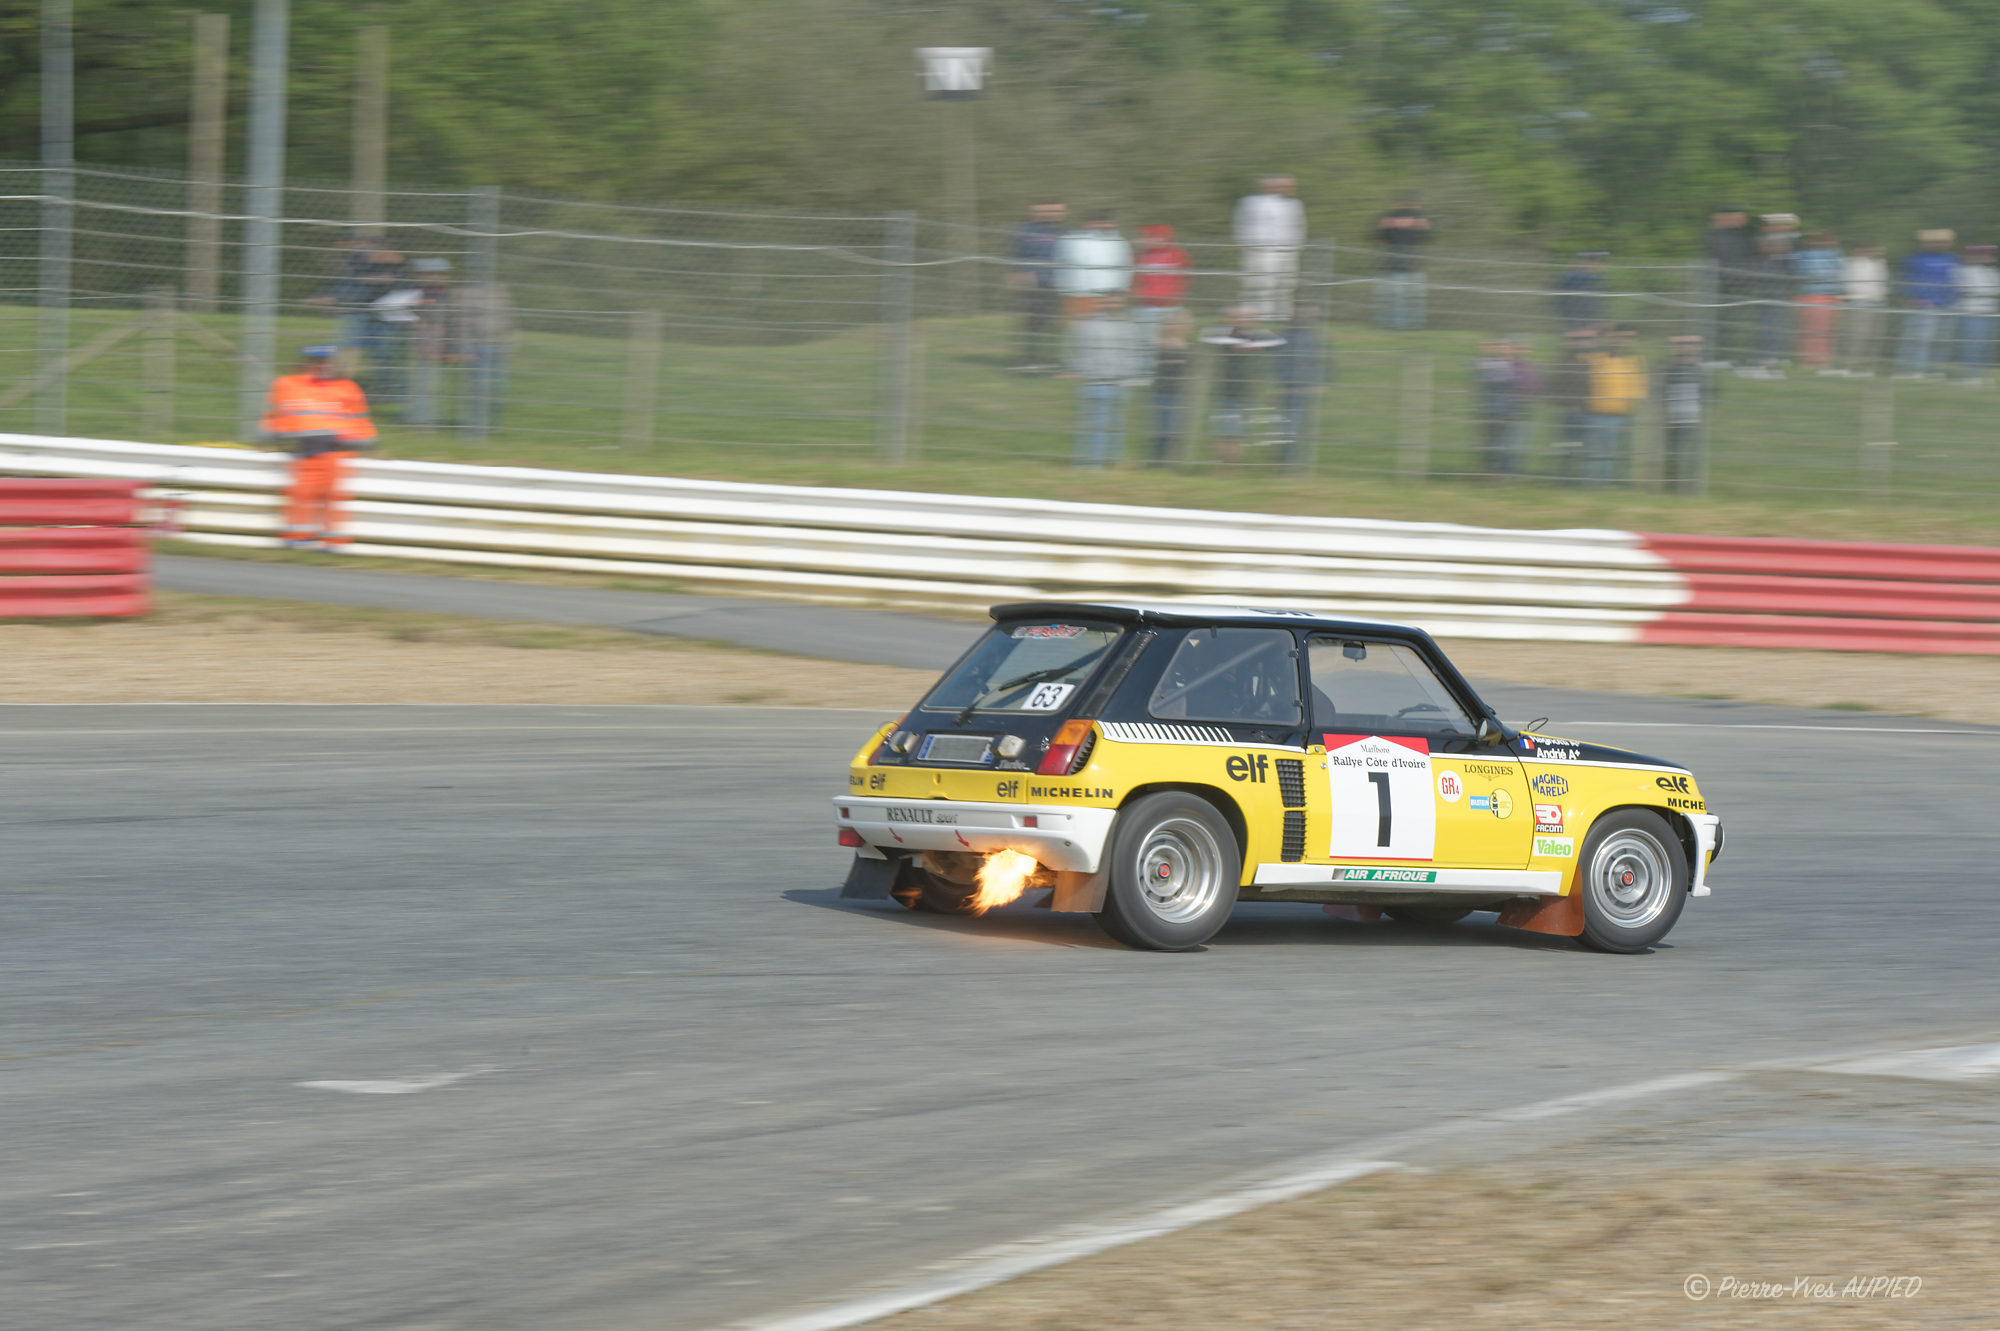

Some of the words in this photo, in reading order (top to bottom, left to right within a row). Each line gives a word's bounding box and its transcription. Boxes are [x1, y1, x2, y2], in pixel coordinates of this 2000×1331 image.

[1032, 685, 1063, 708] 63
[1360, 744, 1390, 754] Marlboro
[1226, 753, 1269, 783] elf
[1333, 756, 1362, 769] Rallye
[1366, 757, 1388, 768] Côte
[1391, 758, 1426, 769] d'Ivoire
[1464, 764, 1514, 775] LONGINES
[996, 780, 1019, 798] elf
[1532, 773, 1569, 791] MAGNETI
[1532, 781, 1569, 797] MARELLI
[1656, 775, 1690, 794] elf
[1031, 786, 1113, 799] MICHELIN
[887, 807, 933, 823] RENAULT
[1367, 771, 1392, 848] 1
[1536, 839, 1573, 856] Valeo
[1344, 868, 1369, 880] AIR
[1372, 870, 1429, 882] AFRIQUE
